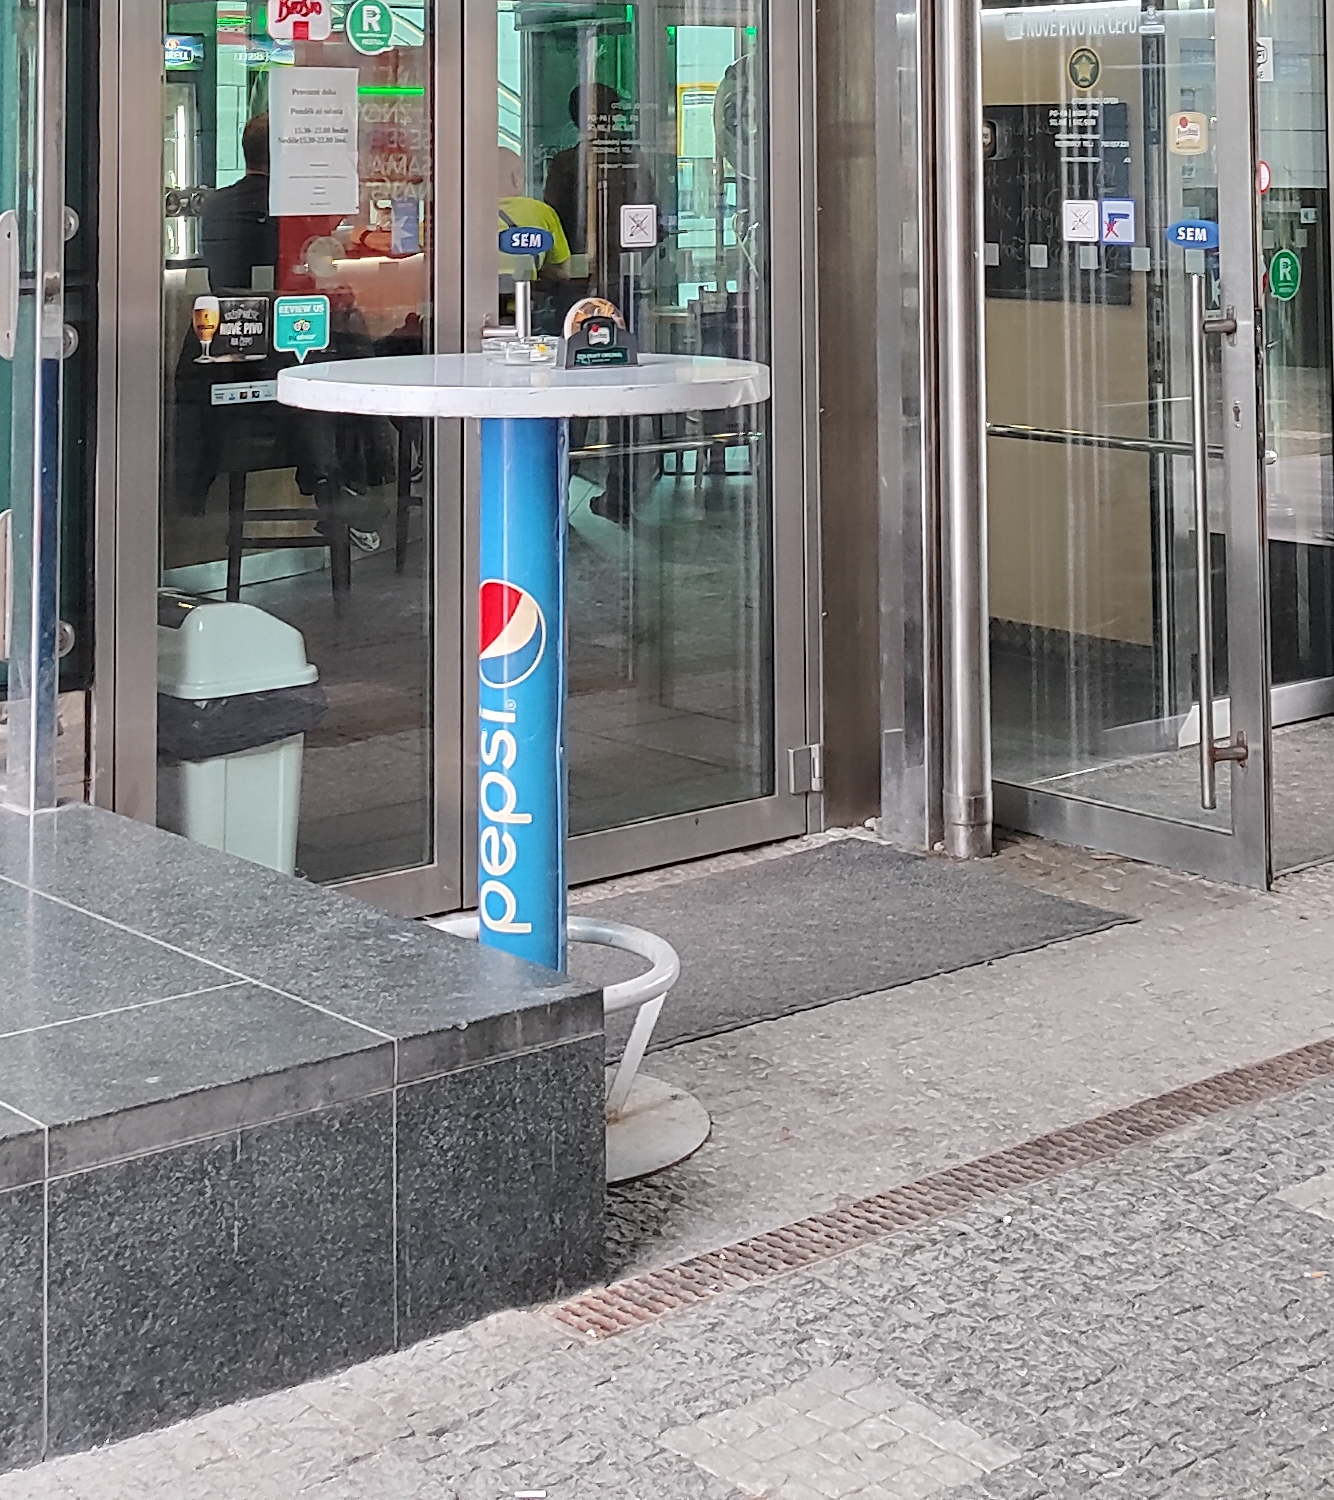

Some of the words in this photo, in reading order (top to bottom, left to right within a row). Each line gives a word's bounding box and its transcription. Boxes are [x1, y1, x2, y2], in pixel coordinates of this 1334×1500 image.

[511, 232, 542, 248] SEM
[1176, 226, 1208, 242] SEM
[279, 305, 311, 314] REVIEW
[312, 304, 325, 313] US
[479, 706, 532, 934] pepsi
